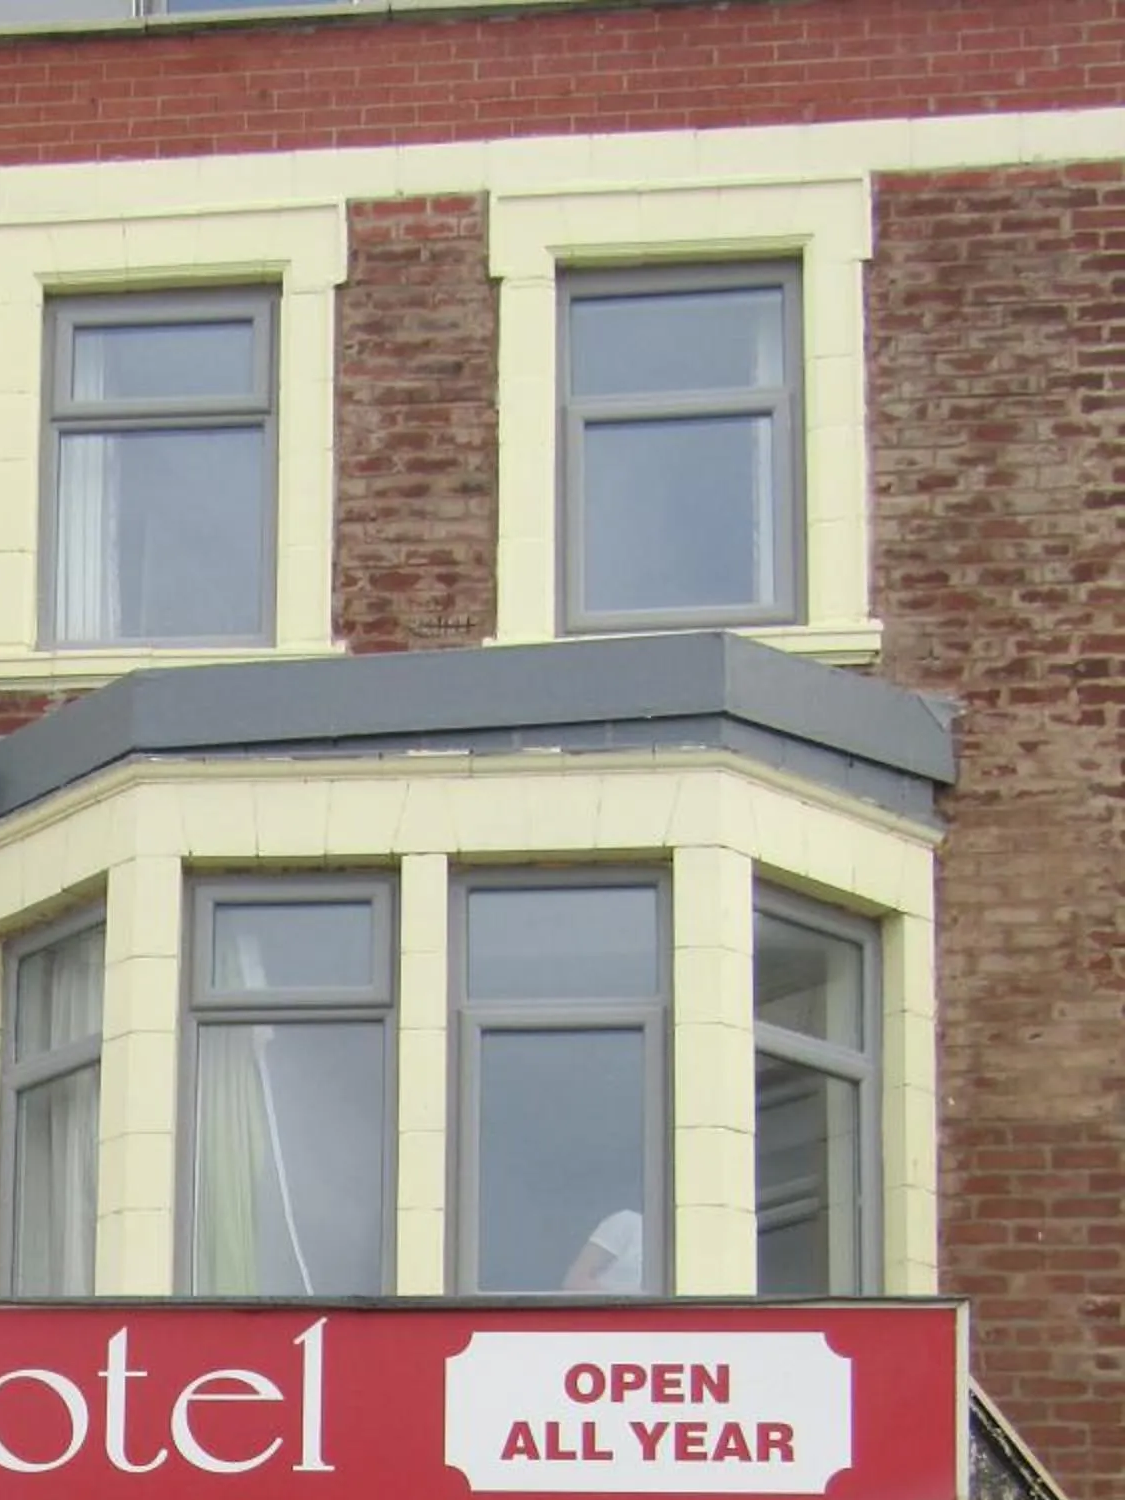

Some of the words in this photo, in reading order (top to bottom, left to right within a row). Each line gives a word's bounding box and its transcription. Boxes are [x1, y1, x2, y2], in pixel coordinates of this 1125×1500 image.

[563, 1362, 731, 1405] OPEN
[500, 1421, 614, 1463] ALL
[627, 1421, 796, 1464] YEAR
